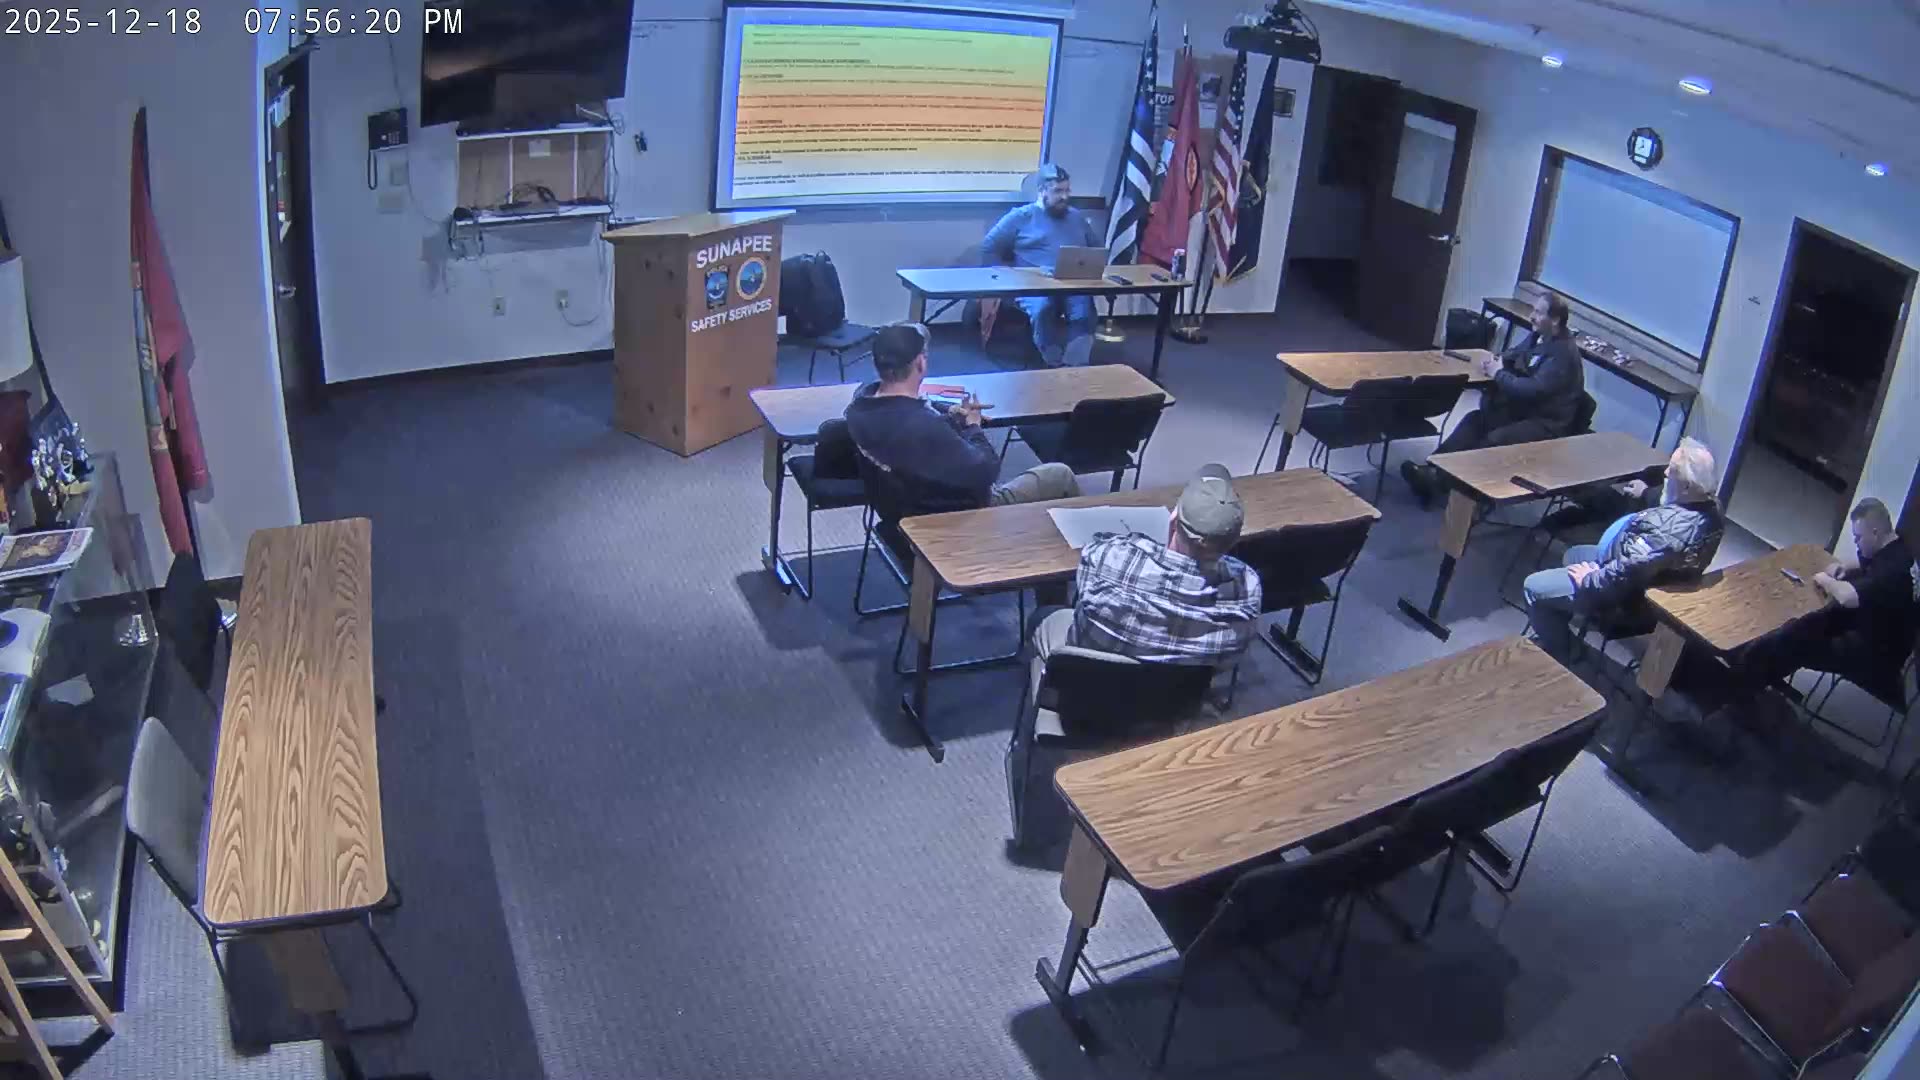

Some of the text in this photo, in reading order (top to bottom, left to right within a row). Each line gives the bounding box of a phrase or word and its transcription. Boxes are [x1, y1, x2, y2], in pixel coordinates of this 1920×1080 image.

[696, 235, 772, 269] SUNAPEE
[691, 299, 772, 333] SAFETY SERVICES
